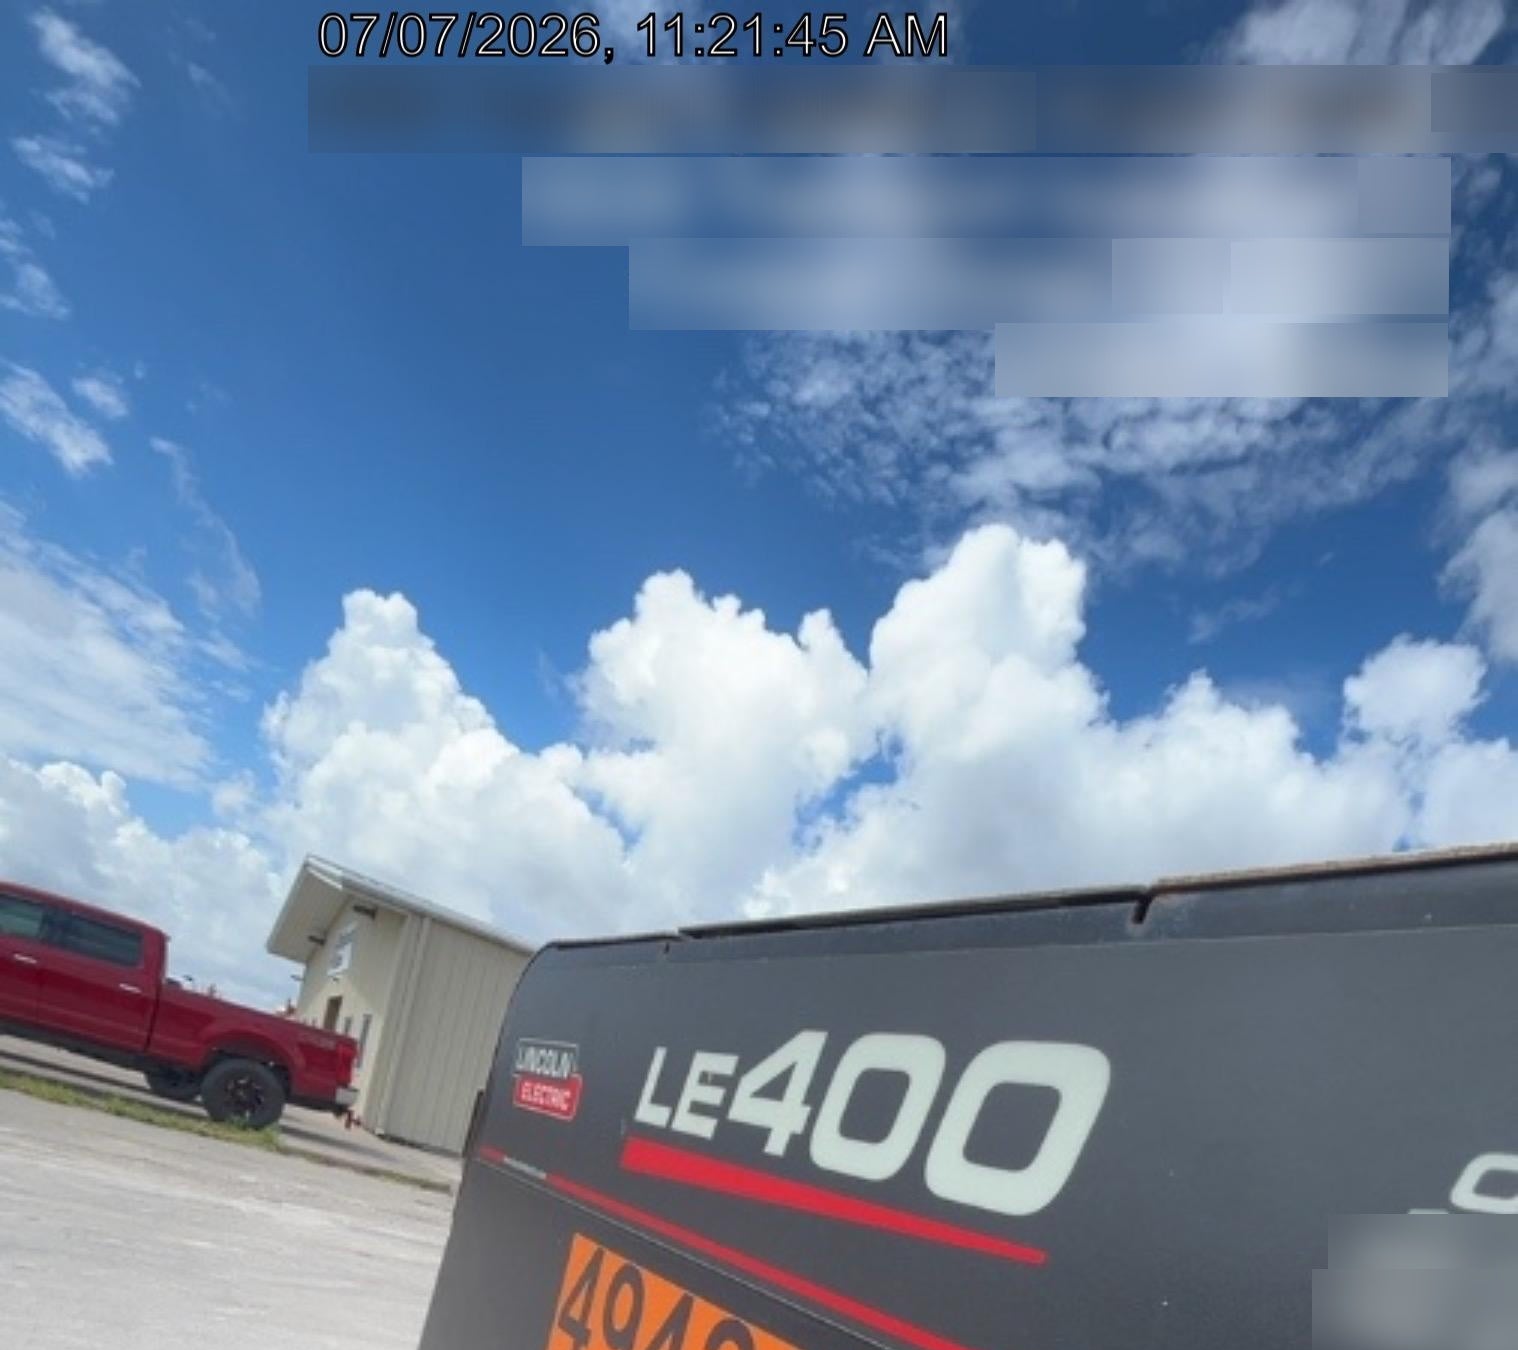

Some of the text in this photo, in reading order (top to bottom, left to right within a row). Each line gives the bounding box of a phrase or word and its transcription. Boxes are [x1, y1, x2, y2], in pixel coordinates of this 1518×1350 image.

[516, 1047, 575, 1079] LINCOLN
[521, 1081, 571, 1111] ELECTRIC
[634, 1030, 1111, 1216] LE400
